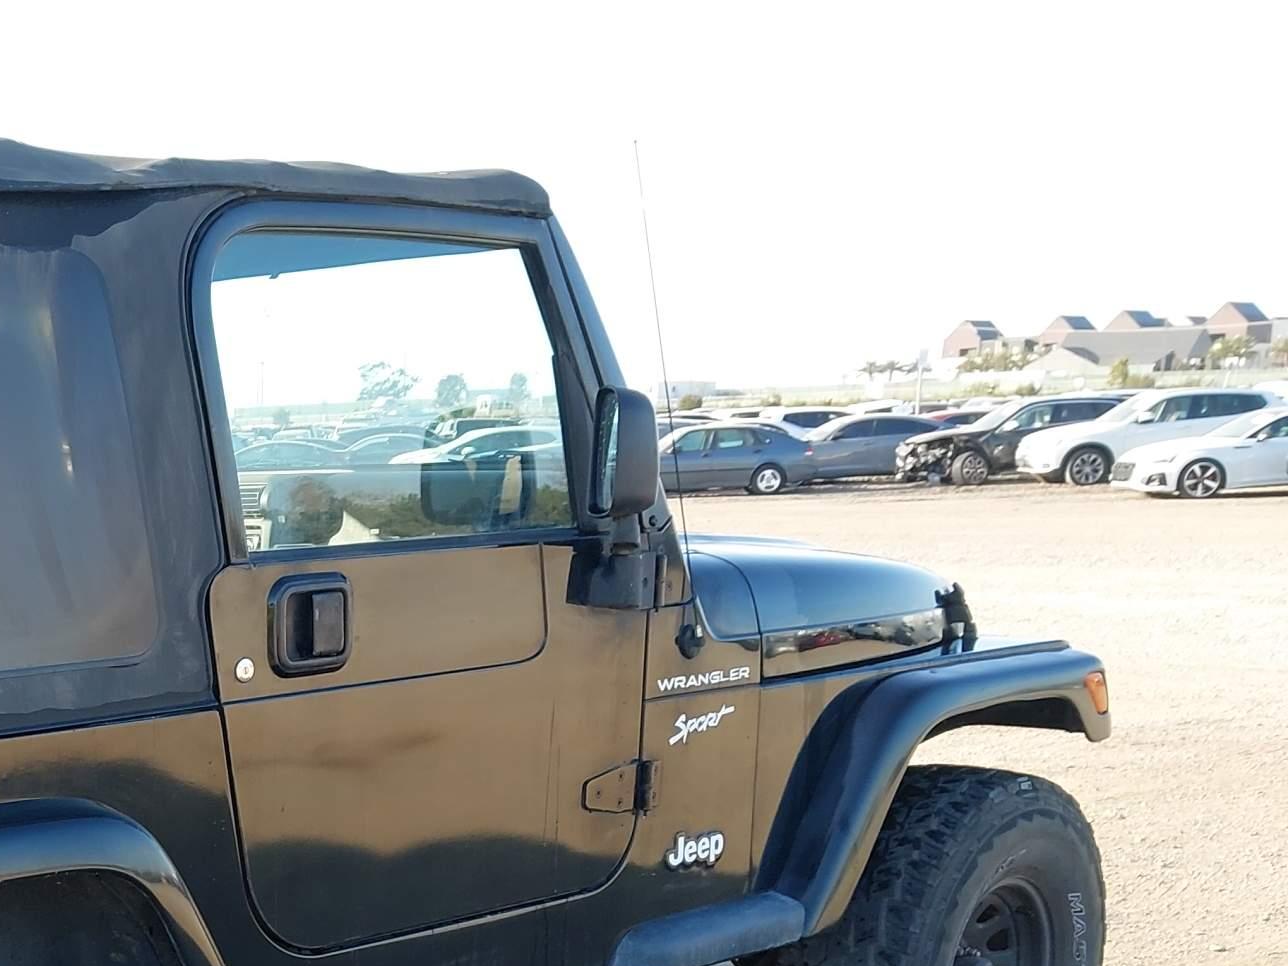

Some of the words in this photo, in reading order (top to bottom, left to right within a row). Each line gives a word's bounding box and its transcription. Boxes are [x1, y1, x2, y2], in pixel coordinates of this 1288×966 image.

[657, 666, 750, 692] WRANGLER
[668, 704, 736, 746] Sport
[668, 832, 724, 867] Jeep
